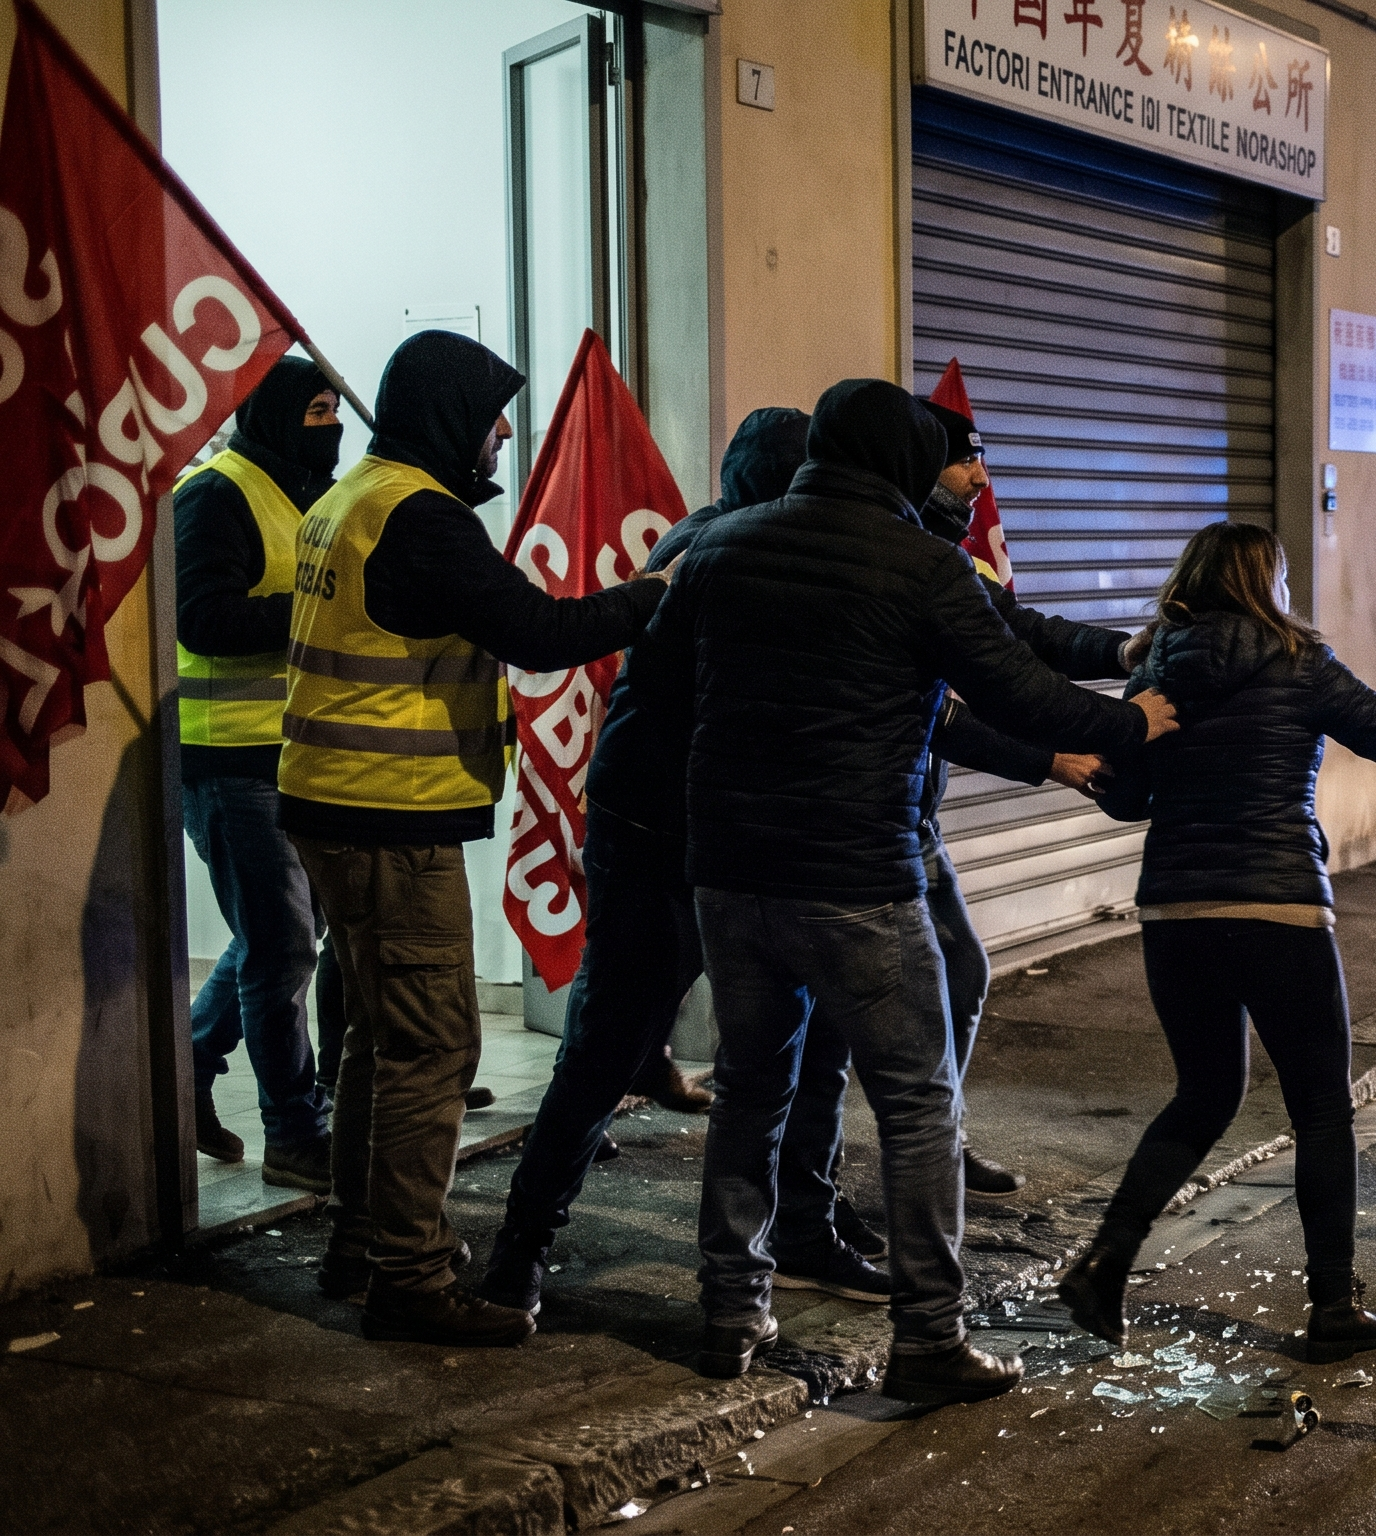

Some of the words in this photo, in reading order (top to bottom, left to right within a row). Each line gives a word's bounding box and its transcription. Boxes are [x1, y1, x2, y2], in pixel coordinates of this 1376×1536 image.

[752, 68, 761, 101] 7
[944, 28, 1029, 92] FACTORI
[1037, 60, 1134, 124] ENTRANCE
[1167, 103, 1230, 153] TEXTILE
[1236, 125, 1316, 178] NORASHOP
